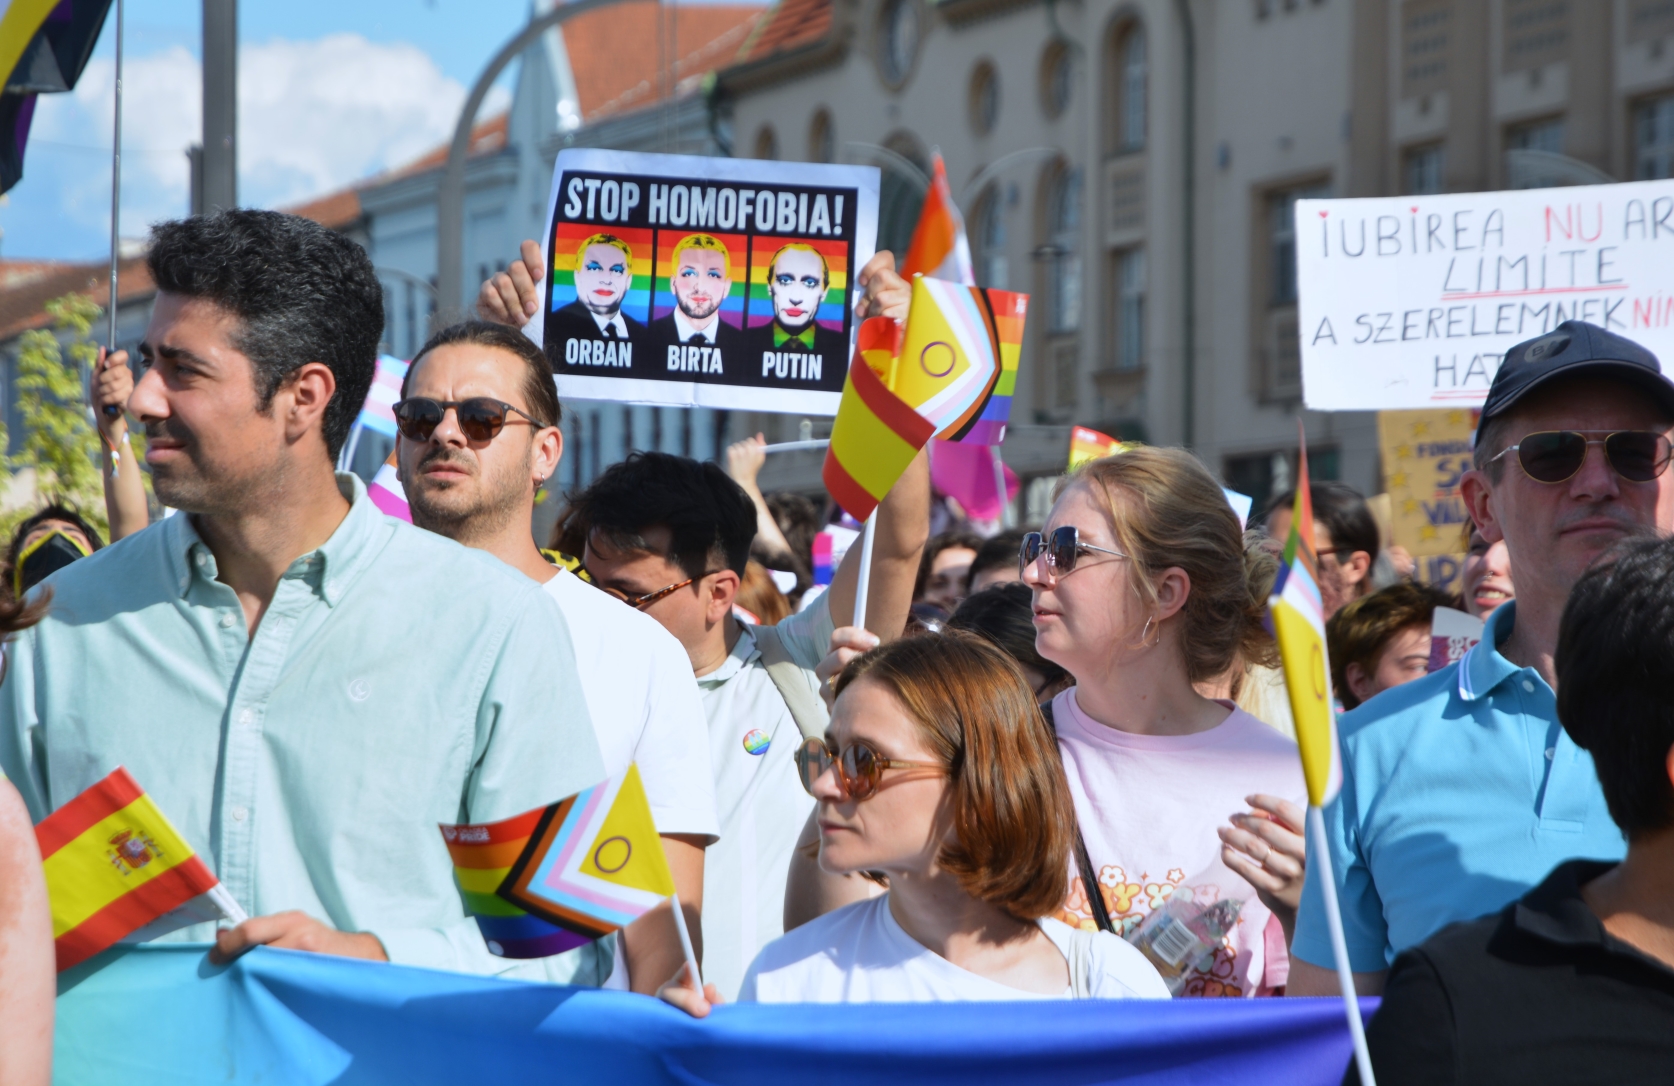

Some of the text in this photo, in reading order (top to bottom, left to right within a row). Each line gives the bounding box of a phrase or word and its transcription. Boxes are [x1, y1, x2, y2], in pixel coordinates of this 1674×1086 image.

[564, 177, 844, 235] STOP HOMOFOBIA!
[1545, 201, 1602, 243] NU
[1312, 316, 1337, 346] A
[1353, 296, 1628, 344] SZERELEMNEK
[565, 338, 633, 369] ORBAN
[667, 344, 723, 375] BIRTA
[762, 351, 823, 380] PUTIN
